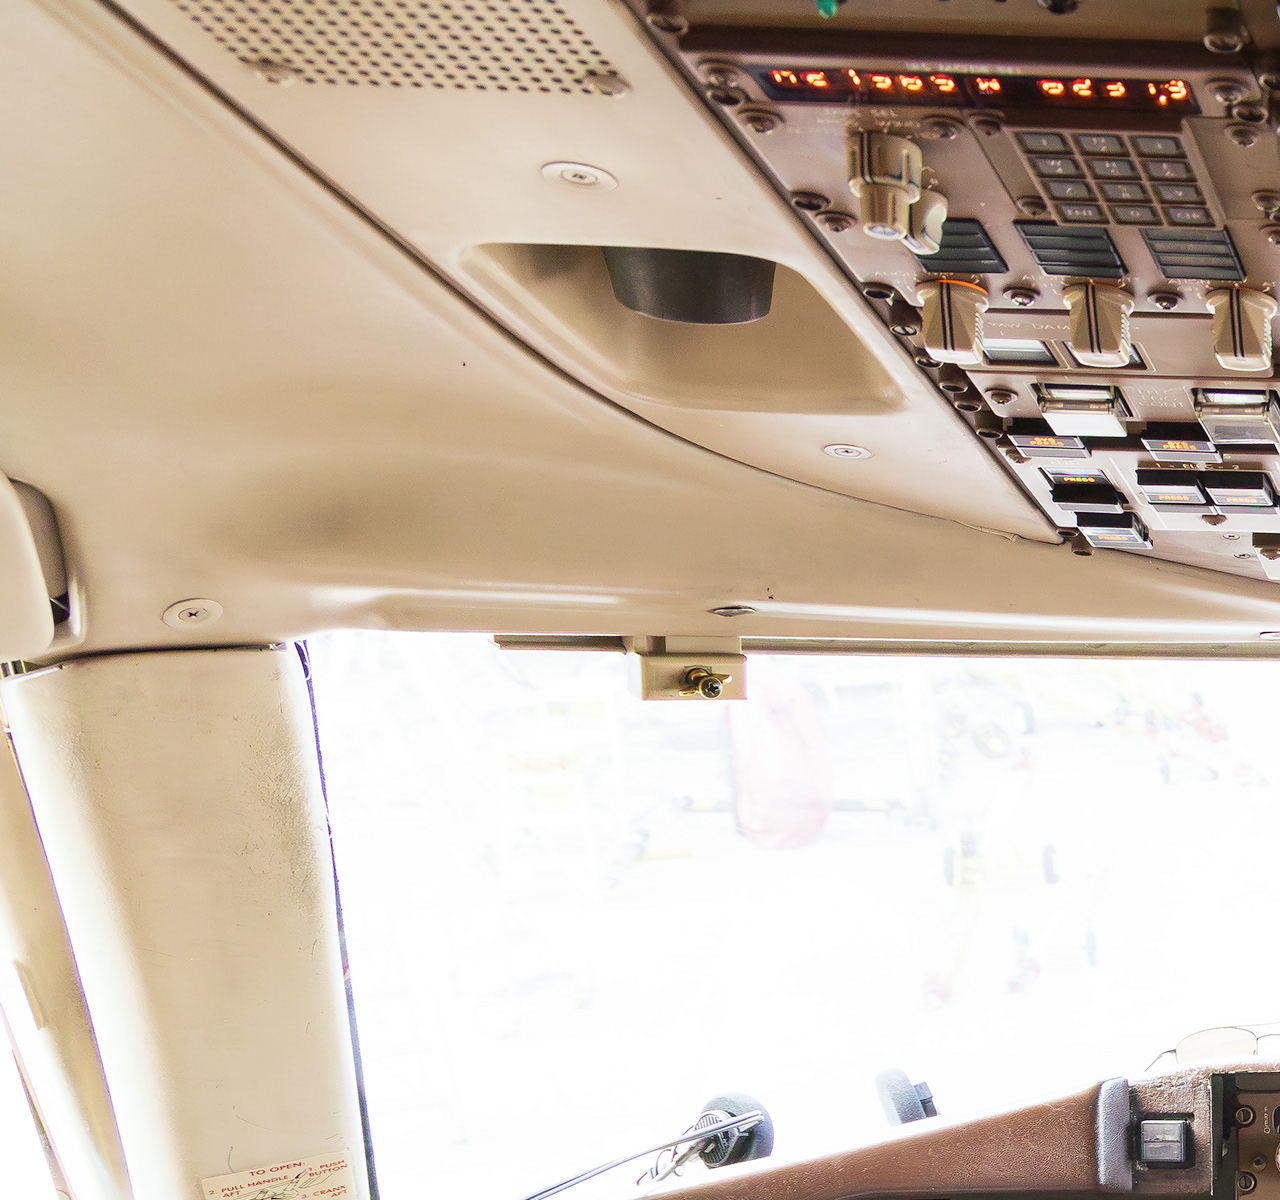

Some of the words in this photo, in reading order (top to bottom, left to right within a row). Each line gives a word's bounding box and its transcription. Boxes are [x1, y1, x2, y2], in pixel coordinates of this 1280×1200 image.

[270, 1162, 305, 1173] OPEN:
[309, 1164, 348, 1177] BUTTON
[221, 1185, 244, 1193] PULL
[248, 1175, 289, 1187] HANDLE
